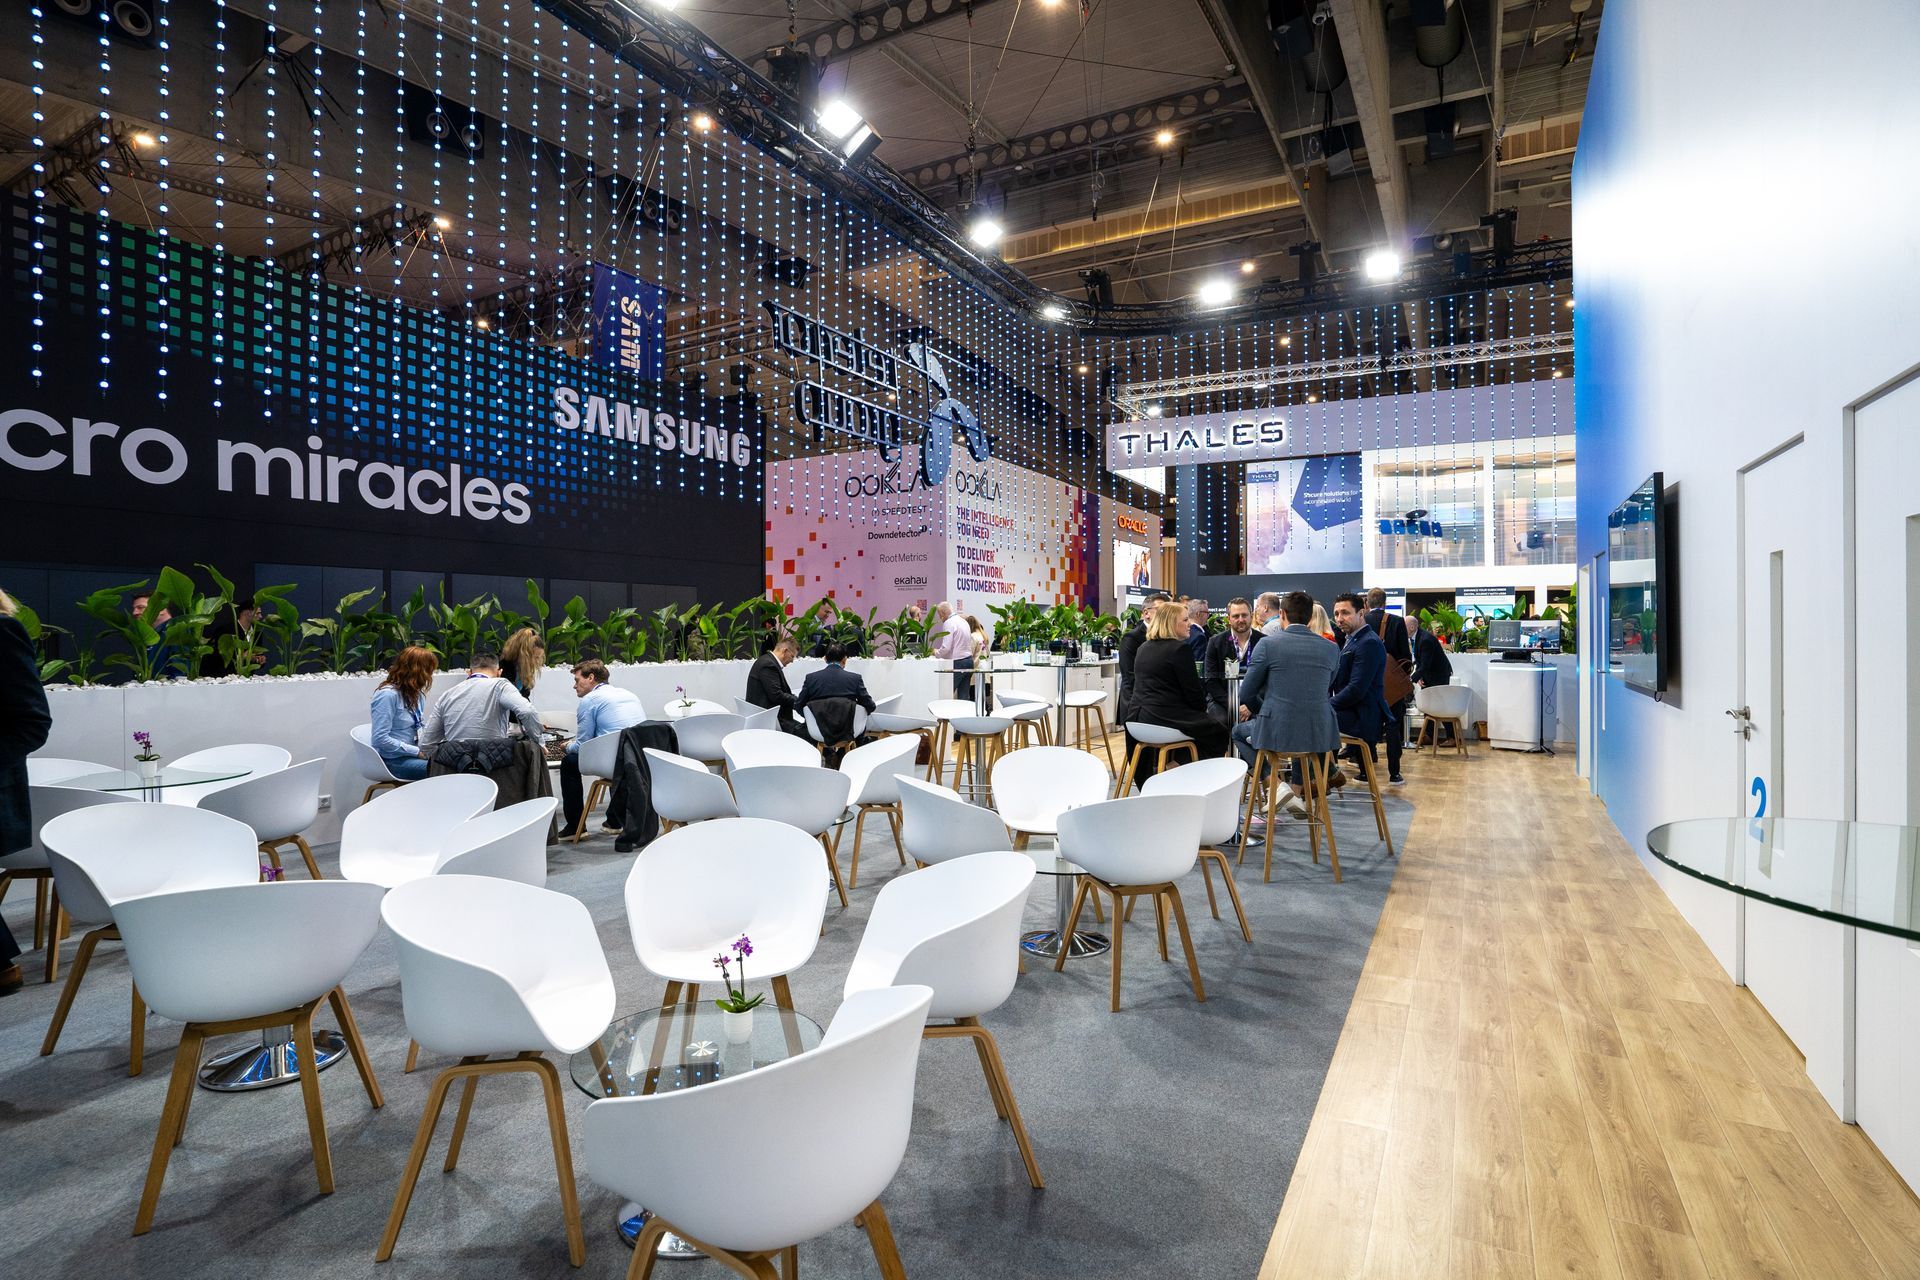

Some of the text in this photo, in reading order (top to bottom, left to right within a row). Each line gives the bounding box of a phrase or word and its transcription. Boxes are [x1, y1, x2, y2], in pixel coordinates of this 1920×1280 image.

[621, 296, 642, 372] SAM
[553, 387, 750, 467] SAMSUNG
[1118, 421, 1284, 454] THALES
[0, 409, 531, 525] cro miracles
[845, 462, 927, 498] OOKLA
[955, 470, 1002, 502] OOKLA
[882, 505, 928, 516] SPEEDTEST
[956, 506, 1014, 529] THE INTELLIGENCE
[868, 529, 921, 540] Downdetector
[956, 522, 990, 540] YOU NEED
[1118, 515, 1148, 535] ORACLE
[956, 545, 995, 563] TO DELIVER
[894, 575, 928, 585] ekahau
[956, 562, 1004, 580] THE NETWORK
[956, 578, 1016, 595] CUSTOMERS TRUST
[1749, 776, 1767, 844] 2
